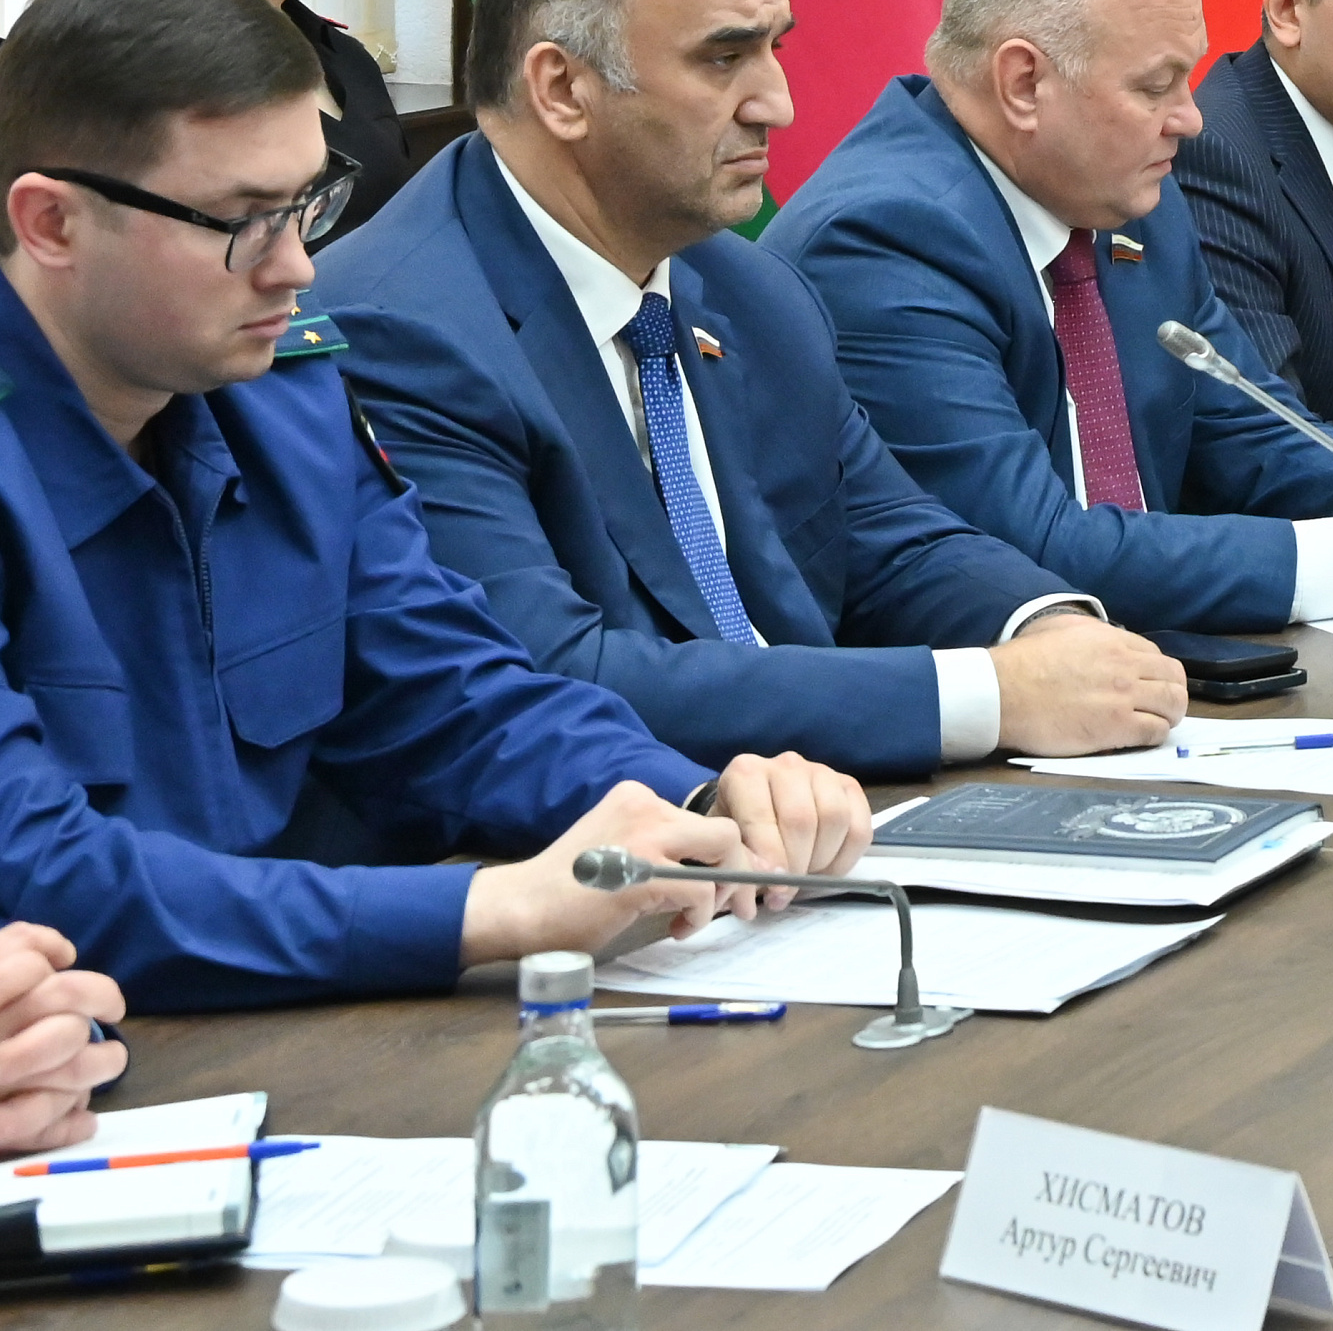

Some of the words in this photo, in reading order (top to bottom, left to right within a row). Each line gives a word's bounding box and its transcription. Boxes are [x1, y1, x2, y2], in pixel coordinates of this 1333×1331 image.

[1034, 1170, 1207, 1237] ХИСМАТОВ
[999, 1216, 1076, 1268] Артур
[1082, 1232, 1218, 1293] Сергеевич
